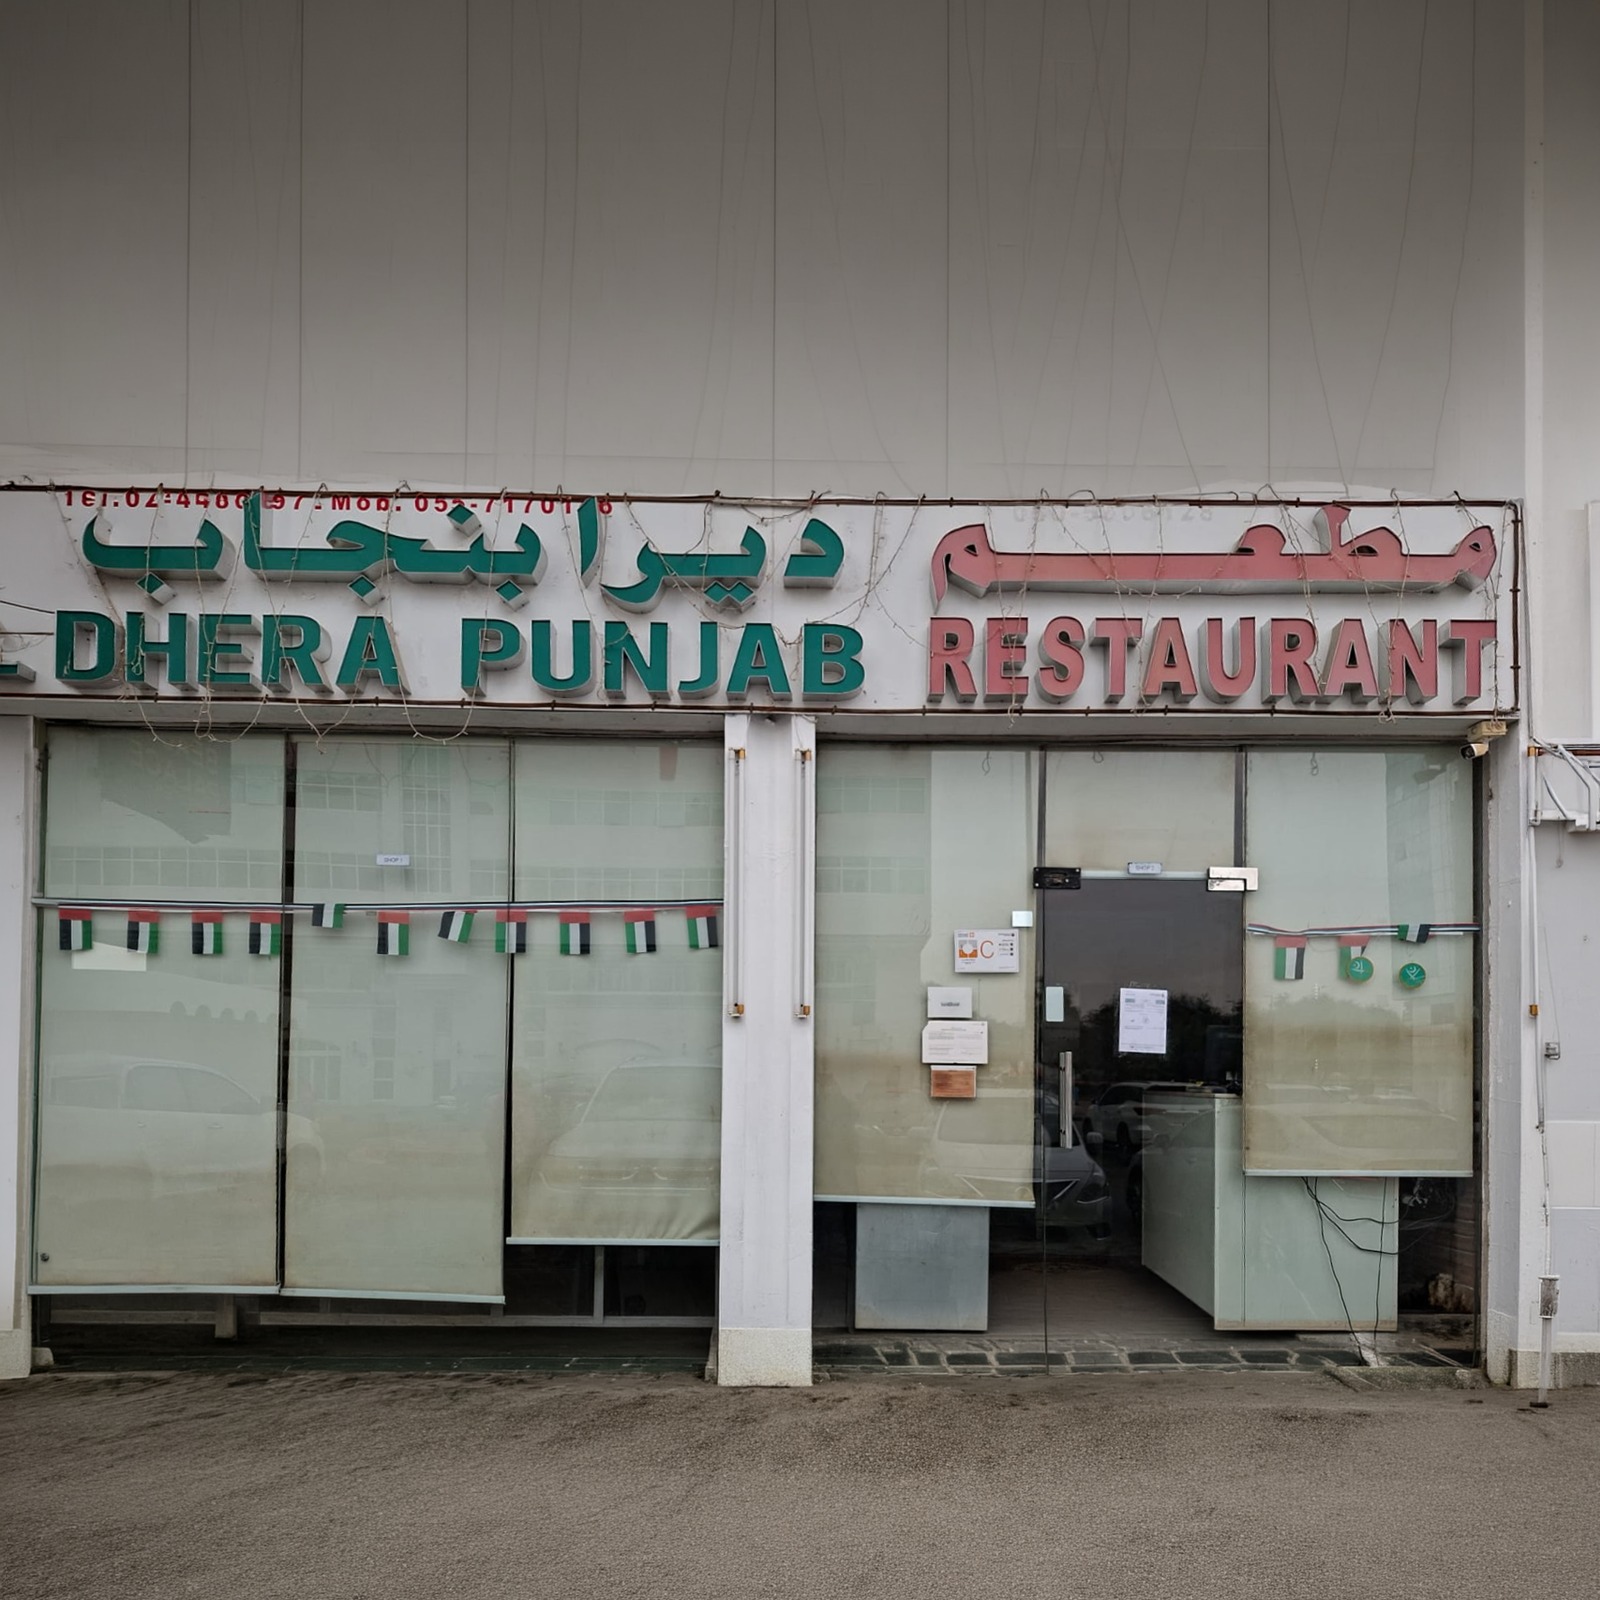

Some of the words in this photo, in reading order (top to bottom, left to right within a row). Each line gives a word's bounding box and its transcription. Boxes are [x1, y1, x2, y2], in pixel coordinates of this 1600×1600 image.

[931, 503, 1497, 610] مطعم
[55, 610, 406, 696] DHERA
[460, 617, 867, 700] PUNJAB
[928, 616, 1498, 703] RESTAURANT
